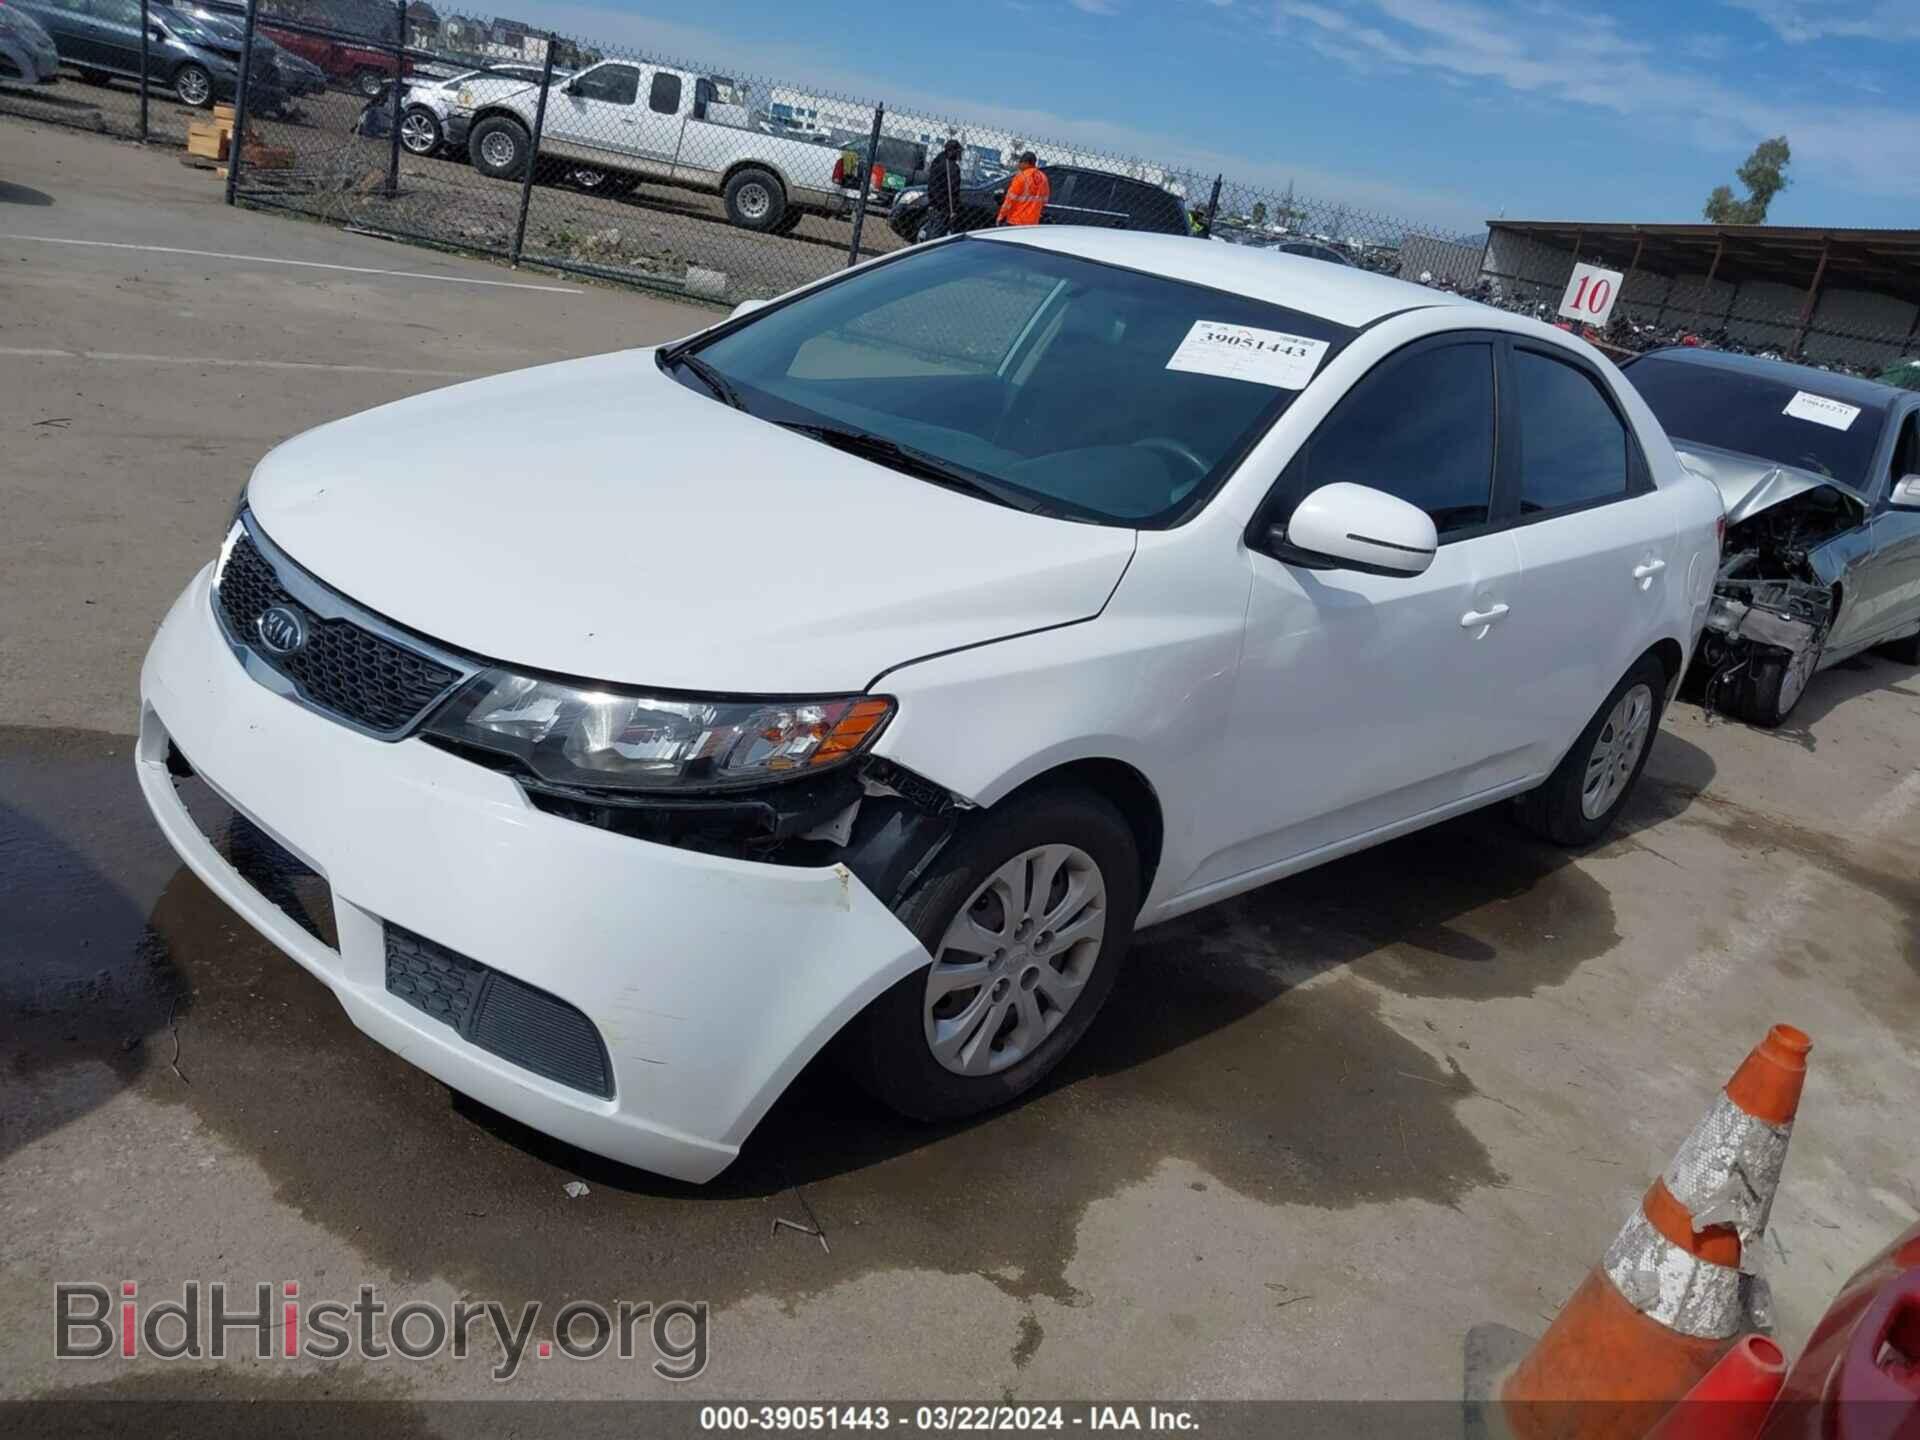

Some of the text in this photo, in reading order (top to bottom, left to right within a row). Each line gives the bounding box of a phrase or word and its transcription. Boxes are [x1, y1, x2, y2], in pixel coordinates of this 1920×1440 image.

[1569, 275, 1610, 314] 10
[1199, 331, 1307, 358] 39051443
[262, 612, 294, 650] KIA
